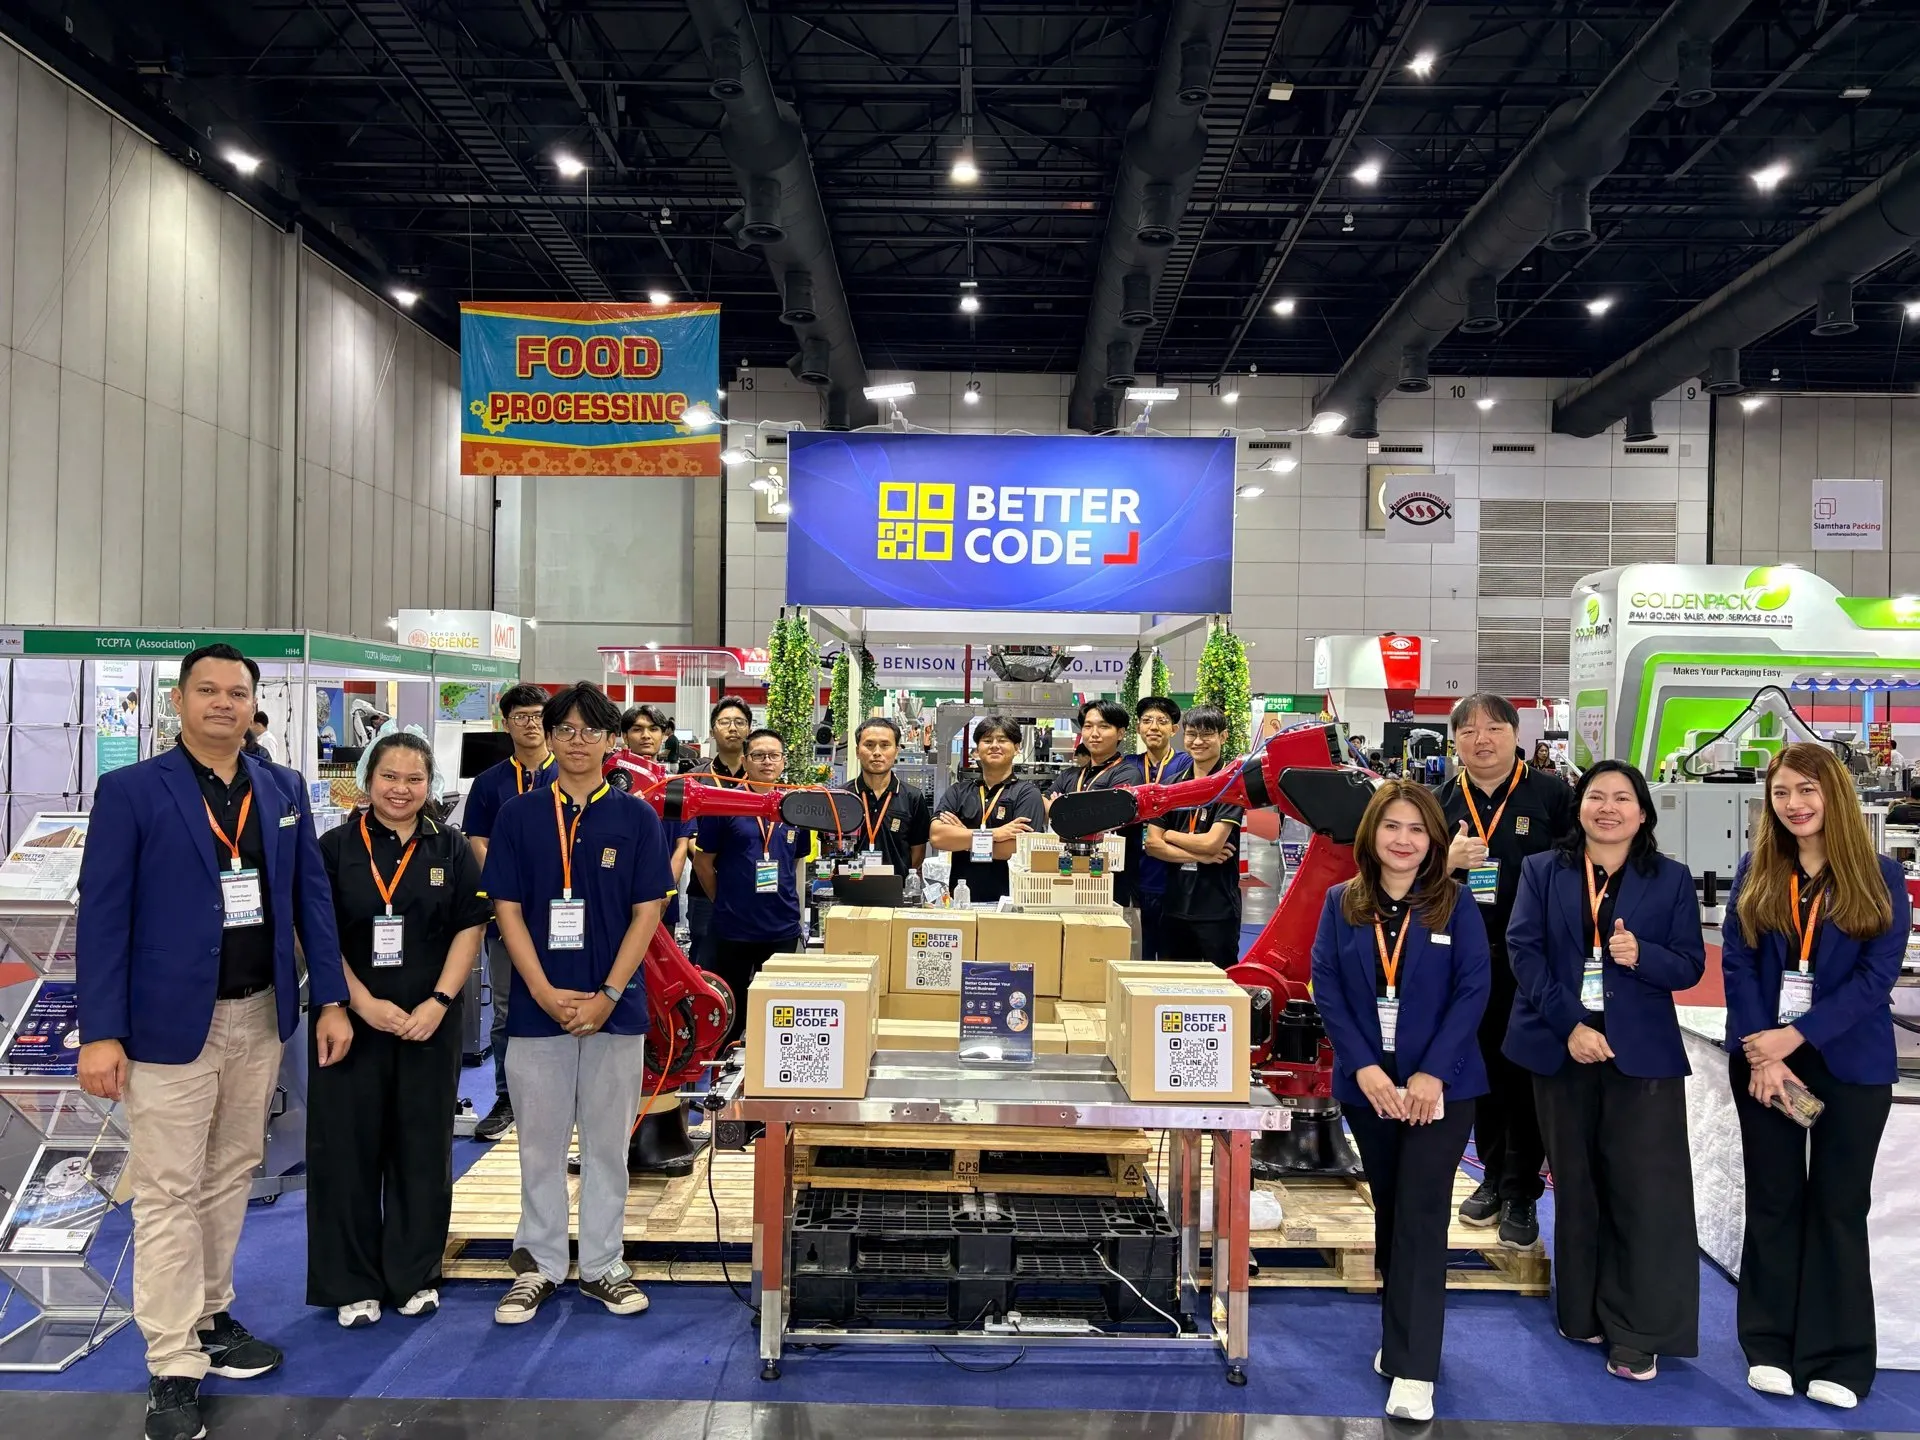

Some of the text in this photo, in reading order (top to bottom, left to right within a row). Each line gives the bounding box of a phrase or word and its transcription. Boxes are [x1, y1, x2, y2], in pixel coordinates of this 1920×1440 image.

[516, 335, 662, 378] FOOD
[739, 377, 754, 391] 13
[966, 381, 981, 394] 12
[1208, 383, 1220, 396] 11
[1450, 385, 1466, 398] 10
[1687, 387, 1697, 400] 9
[488, 391, 689, 423] PROCESSING
[967, 485, 1141, 525] BETTER
[1813, 522, 1881, 531] Siamthara Packing
[965, 528, 1092, 566] CODE
[1631, 592, 1753, 611] GOLDENPACK
[1650, 612, 1681, 621] GOLDEN
[1728, 614, 1762, 623] SERVICES
[95, 637, 196, 650] TCCPTA (Association)
[285, 648, 300, 656] HH4
[883, 656, 956, 671] BENISON
[1673, 666, 1784, 679] Makes Your Packaging Easy.
[1446, 679, 1458, 690] 10
[226, 909, 258, 920] EXHIBITOR
[928, 933, 958, 941] BETTER
[928, 940, 950, 948] CODE
[796, 1007, 838, 1018] BETTER
[1184, 1012, 1226, 1023] BETTER
[795, 1017, 828, 1028] CODE
[1184, 1022, 1216, 1033] CODE
[796, 1054, 813, 1062] LINE
[1185, 1059, 1202, 1067] LINE
[958, 1161, 979, 1173] CP9
